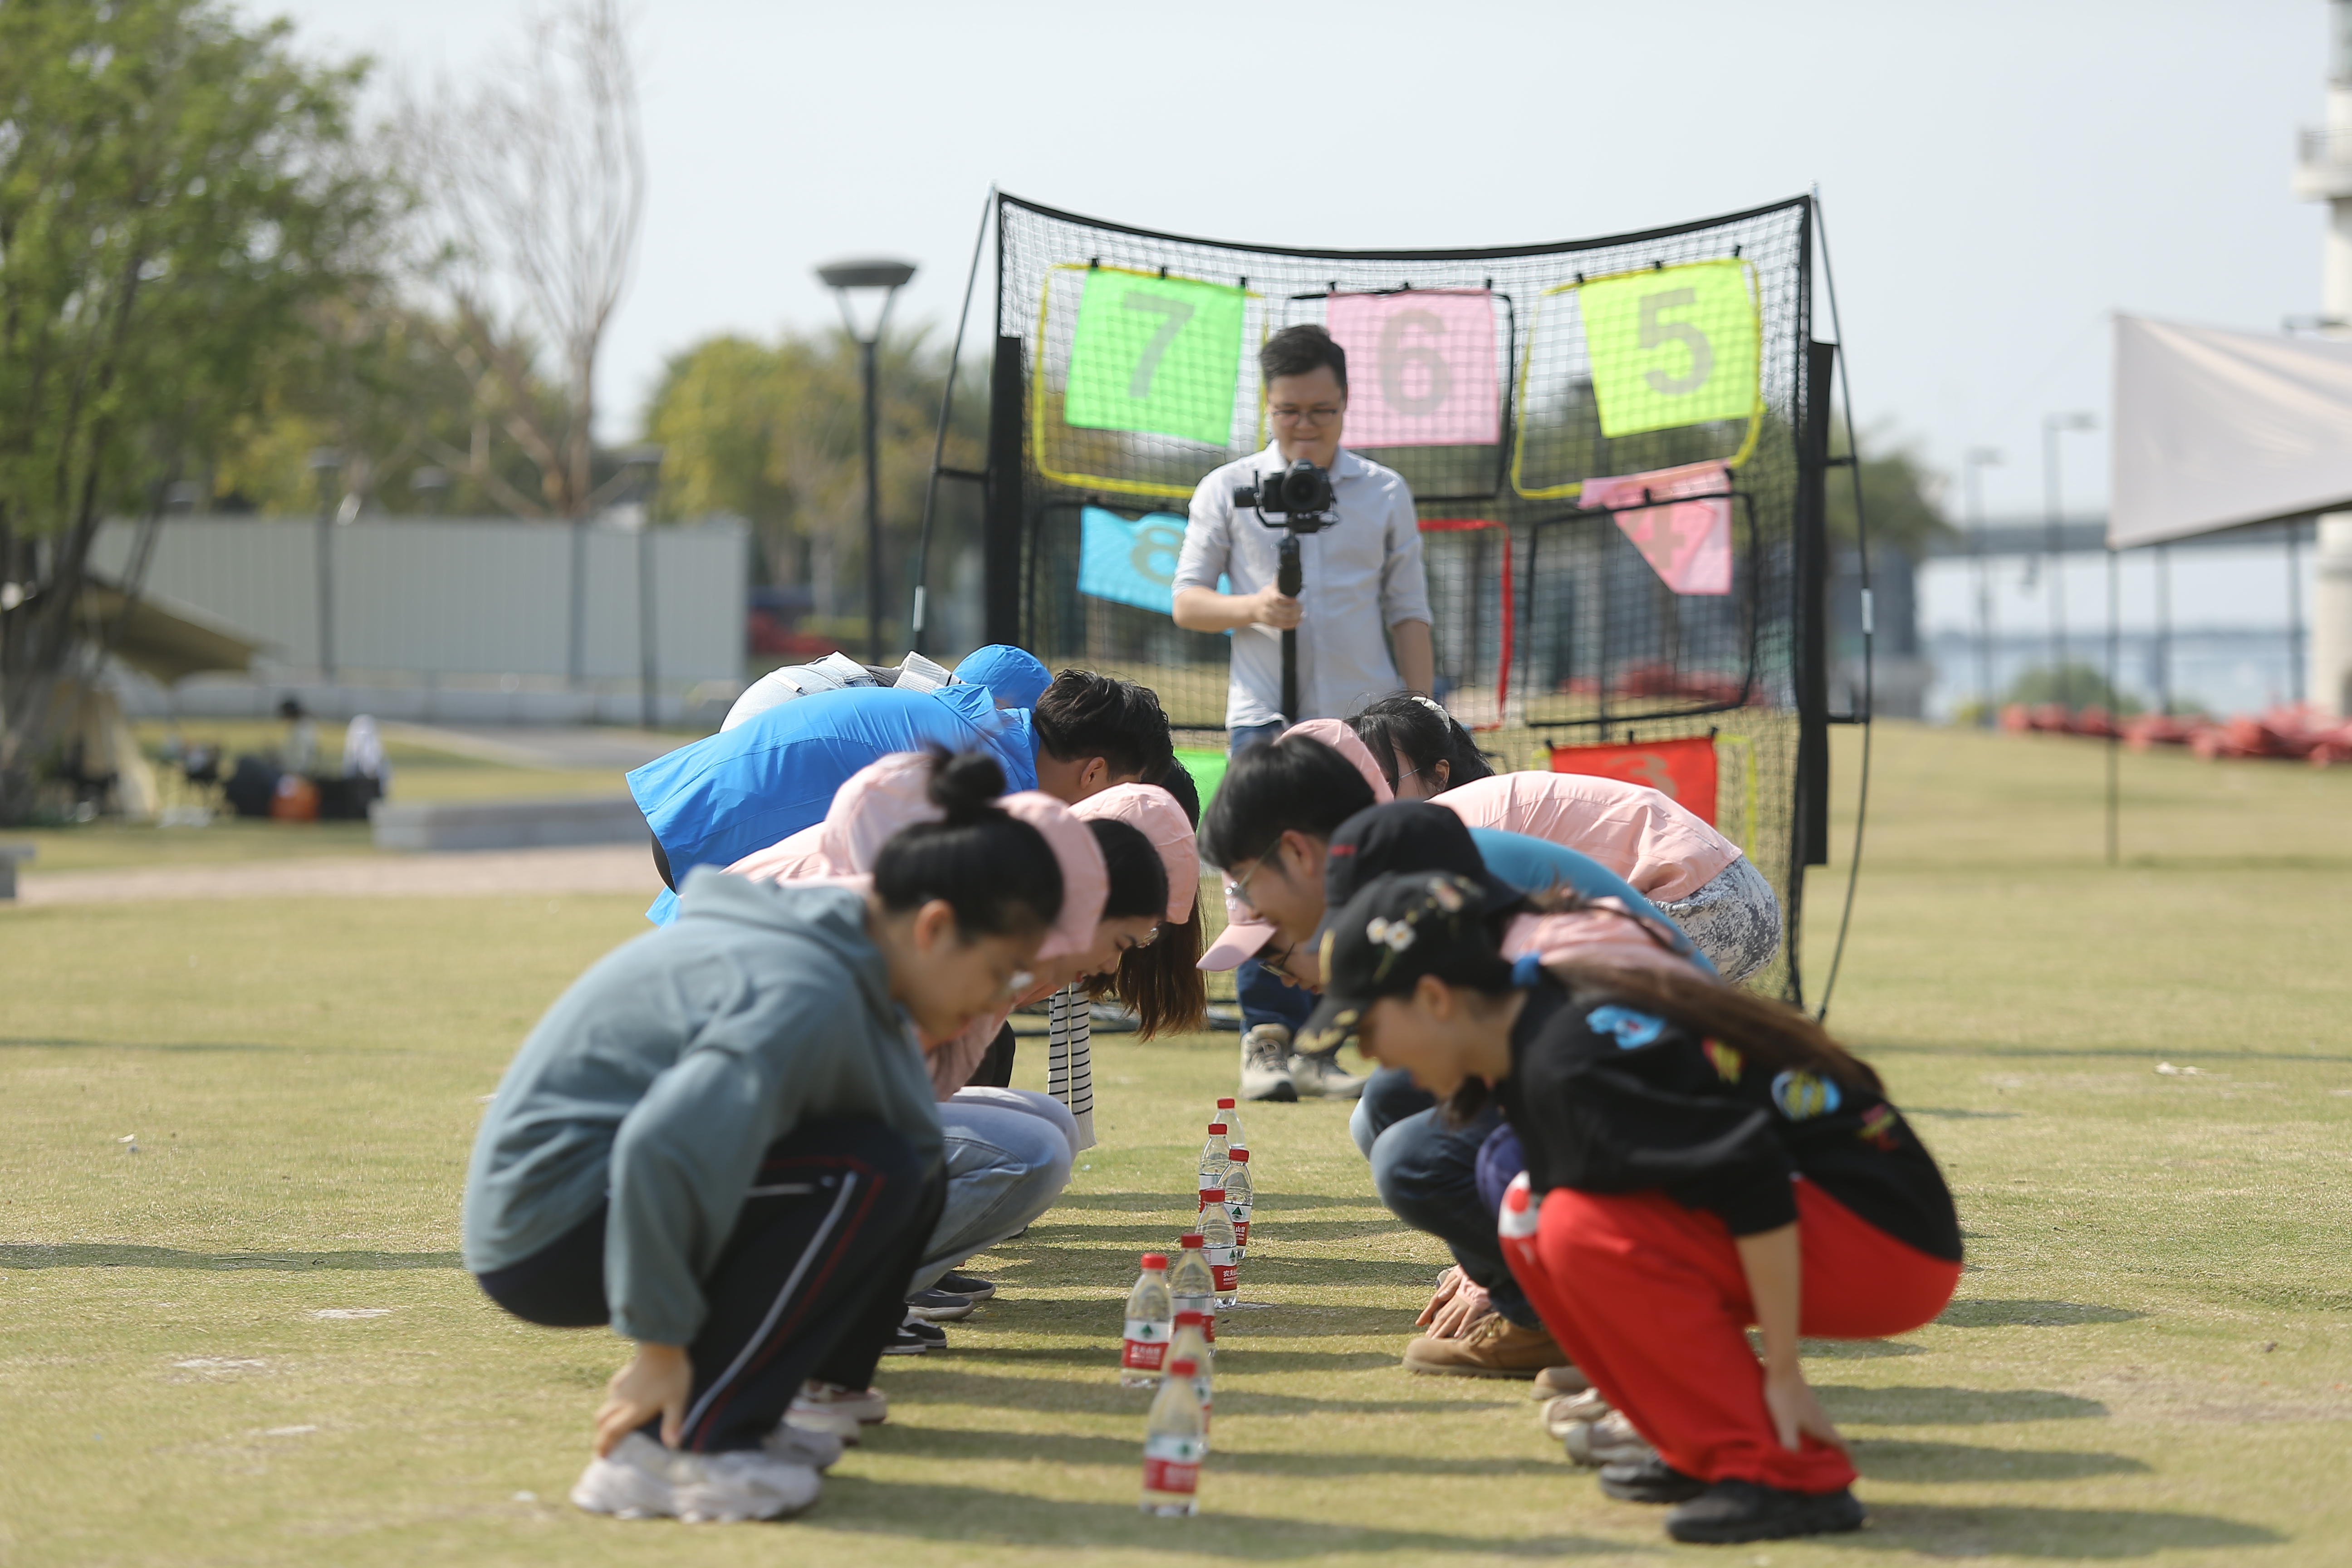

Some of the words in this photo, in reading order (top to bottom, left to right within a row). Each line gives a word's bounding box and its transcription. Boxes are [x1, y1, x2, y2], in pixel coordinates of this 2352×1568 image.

[1124, 289, 1195, 397] 7
[1377, 309, 1449, 415] 6
[1638, 288, 1712, 394] 5
[1129, 526, 1187, 587] 8
[1621, 504, 1686, 569] 4
[1602, 751, 1678, 800] 3
